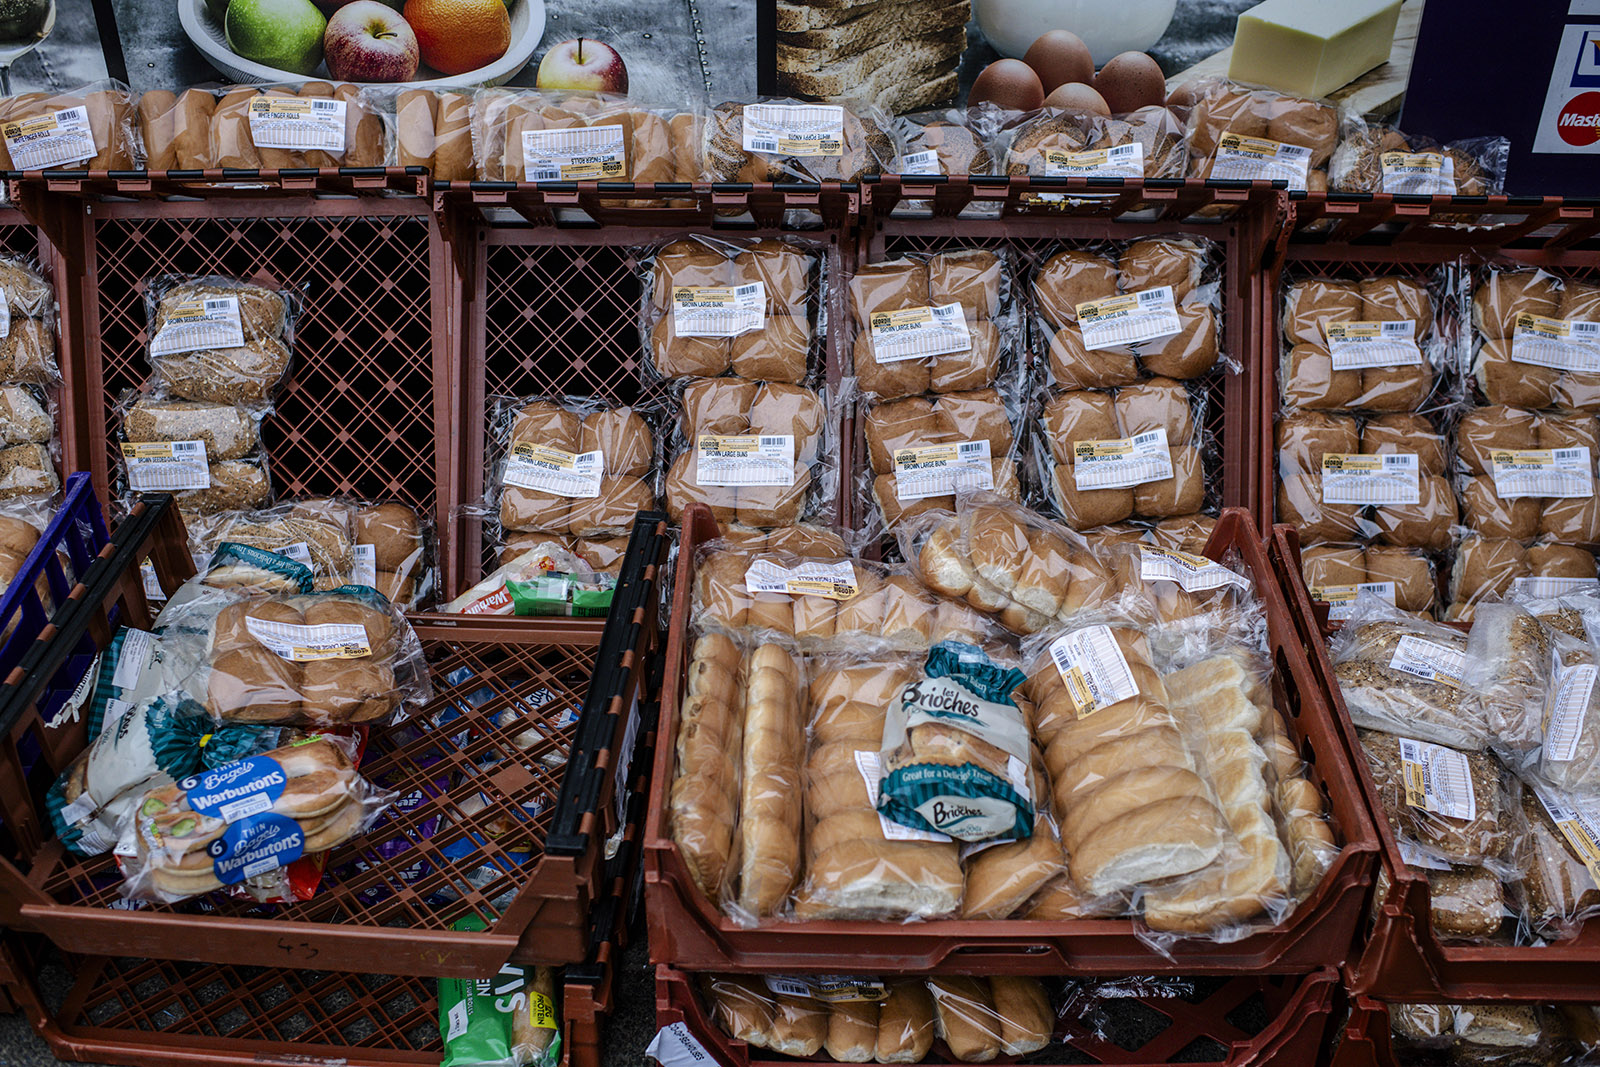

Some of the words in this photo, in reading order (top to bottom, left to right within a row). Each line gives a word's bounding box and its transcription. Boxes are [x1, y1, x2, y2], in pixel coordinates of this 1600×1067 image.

[13, 136, 26, 144] WHITE
[26, 133, 40, 141] FINGER
[39, 130, 50, 138] ROLLS
[1086, 315, 1103, 323] BROWN
[1102, 313, 1117, 321] LARGE
[1116, 310, 1129, 318] BUNS
[880, 325, 895, 333] BROWN
[895, 323, 910, 331] LARGE
[518, 455, 533, 464] BROWN
[533, 459, 548, 468] LARGE
[548, 462, 560, 471] BUNS
[920, 461, 935, 469] LARGE
[934, 459, 947, 468] BUNS
[1082, 455, 1097, 463] BROWN
[1097, 454, 1111, 462] LARGE
[1110, 453, 1123, 461] BUNS
[247, 549, 273, 565] Delicious
[901, 681, 980, 718] Brioches
[942, 687, 954, 698] les
[182, 776, 197, 789] 6
[204, 762, 255, 790] Bagels
[902, 769, 923, 782] Great
[923, 768, 936, 779] for
[192, 771, 284, 810] Warburtons
[933, 801, 983, 826] Brioches
[242, 823, 266, 839] THIN
[211, 840, 223, 855] 6
[234, 825, 280, 856] Bagels
[218, 832, 301, 874] Warburtons
[466, 998, 474, 1016] ROLLS
[536, 994, 545, 1025] PROTEIN
